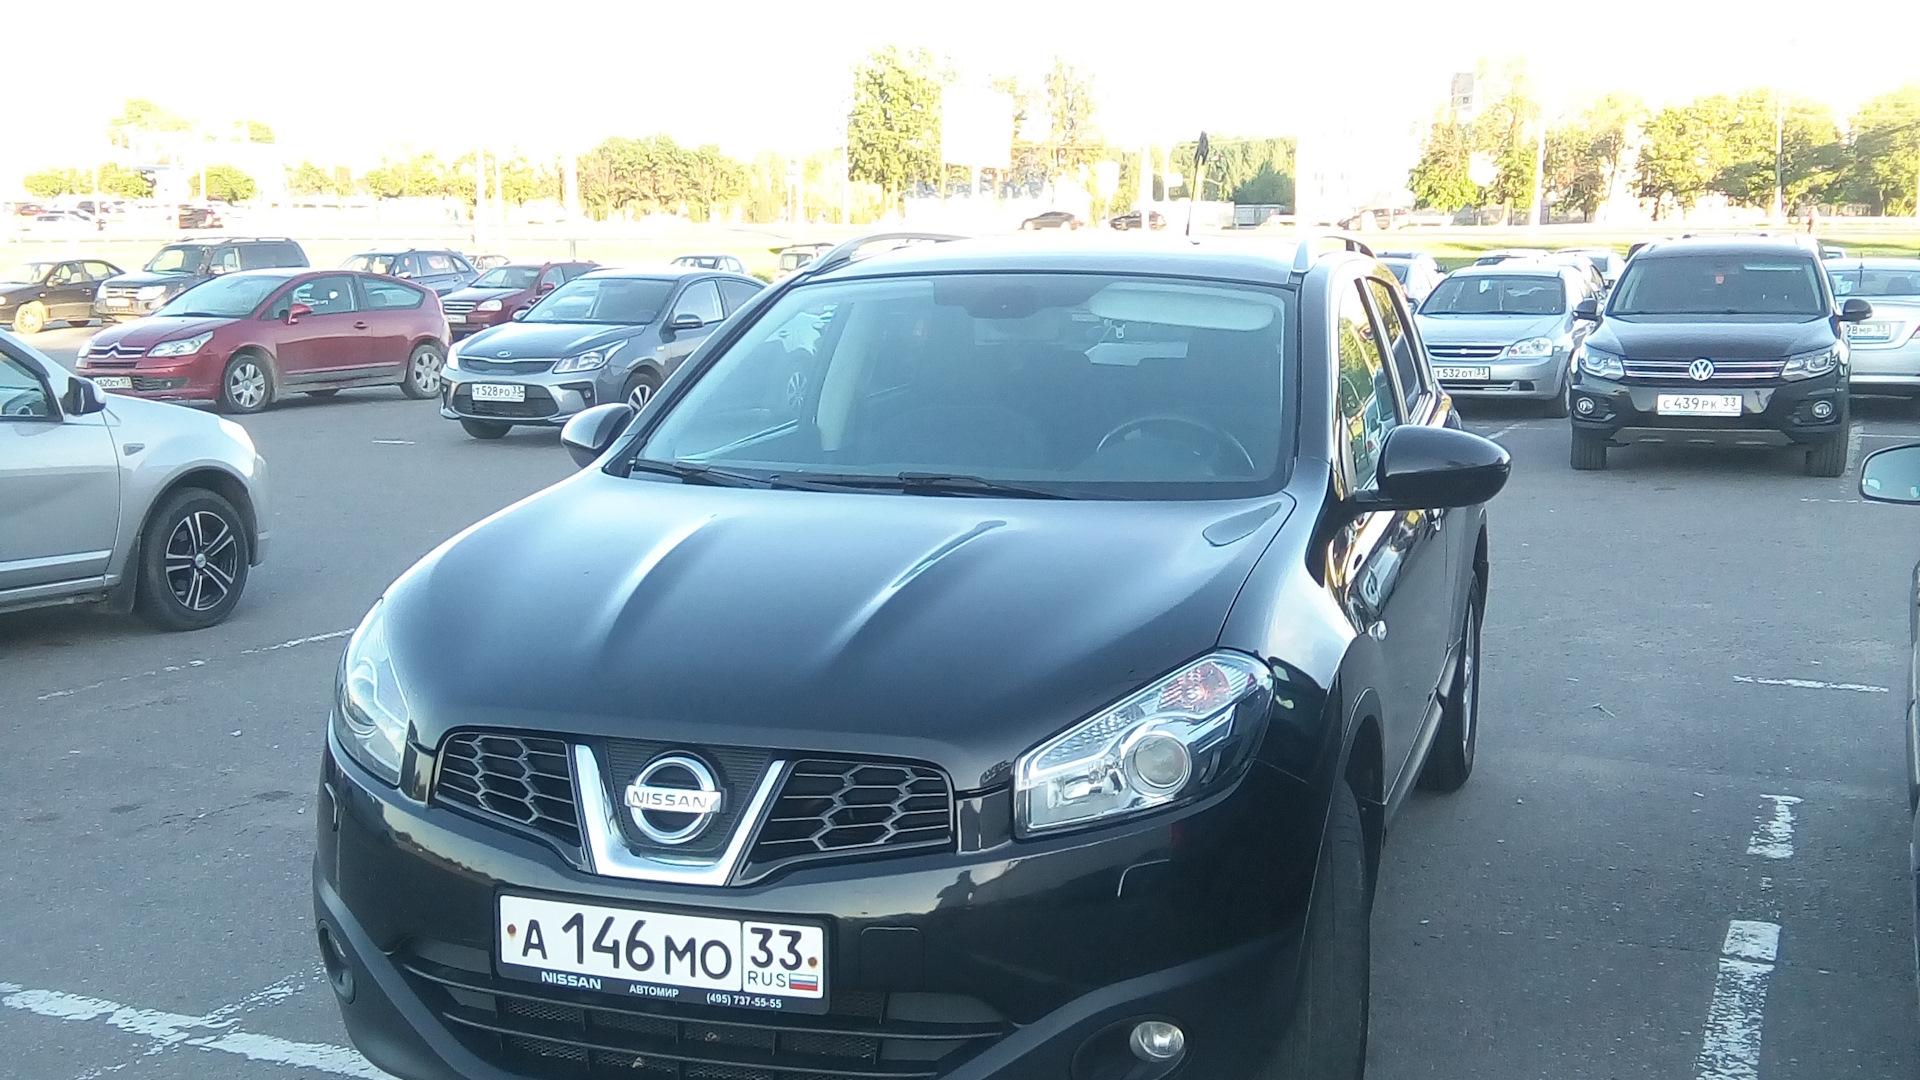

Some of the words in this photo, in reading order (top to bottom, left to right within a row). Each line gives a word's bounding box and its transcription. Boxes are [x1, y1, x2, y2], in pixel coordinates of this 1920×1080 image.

[632, 791, 707, 808] NISSAN
[750, 927, 803, 971] 33
[541, 971, 602, 990] NISSAN
[747, 970, 786, 988] RUS
[628, 983, 679, 998] АВТОМИР
[706, 992, 732, 1006] (495)
[733, 994, 782, 1009] 737-55-55
